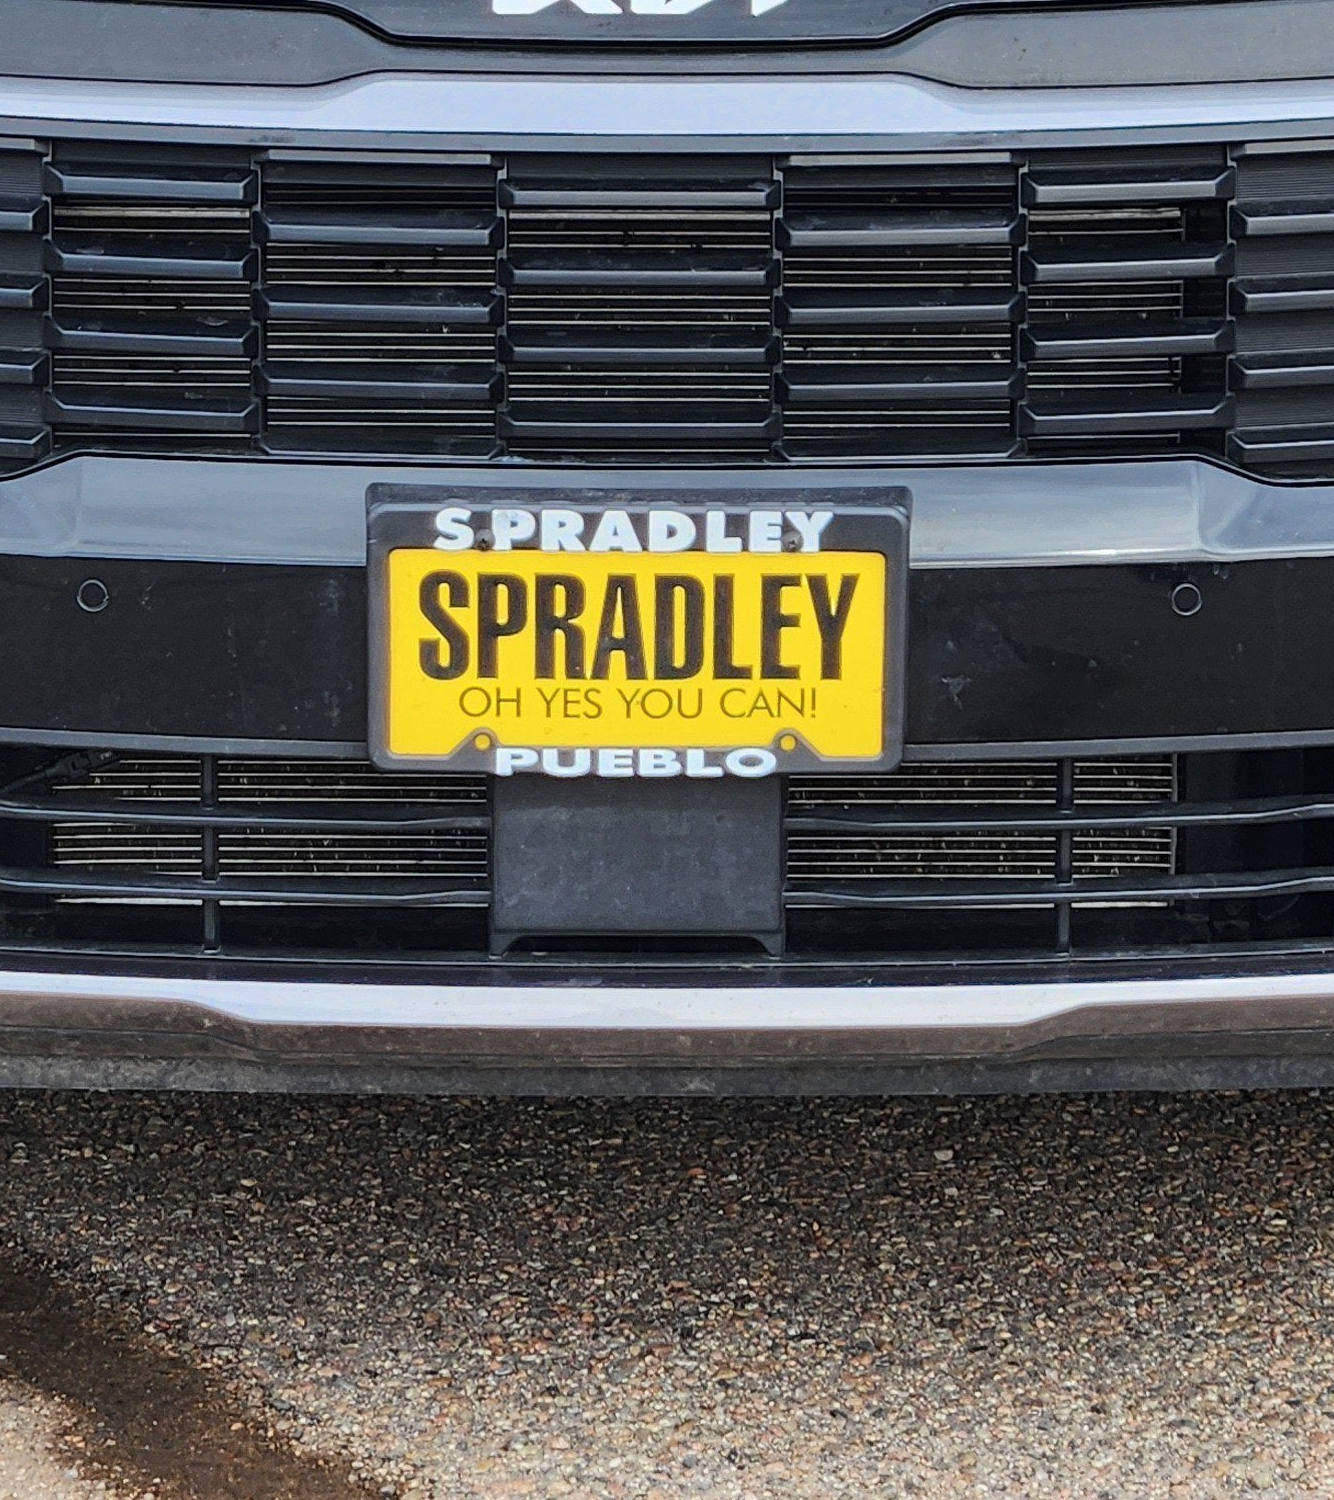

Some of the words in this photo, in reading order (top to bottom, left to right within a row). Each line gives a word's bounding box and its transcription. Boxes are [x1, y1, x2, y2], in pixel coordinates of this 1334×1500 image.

[432, 506, 835, 553] SPRADLEY
[418, 568, 862, 682] SPRADLEY
[458, 686, 522, 719] OH
[535, 687, 604, 719] YES
[615, 687, 704, 720] YOU
[719, 686, 817, 720] CAN!
[495, 746, 778, 778] PUEBLO
